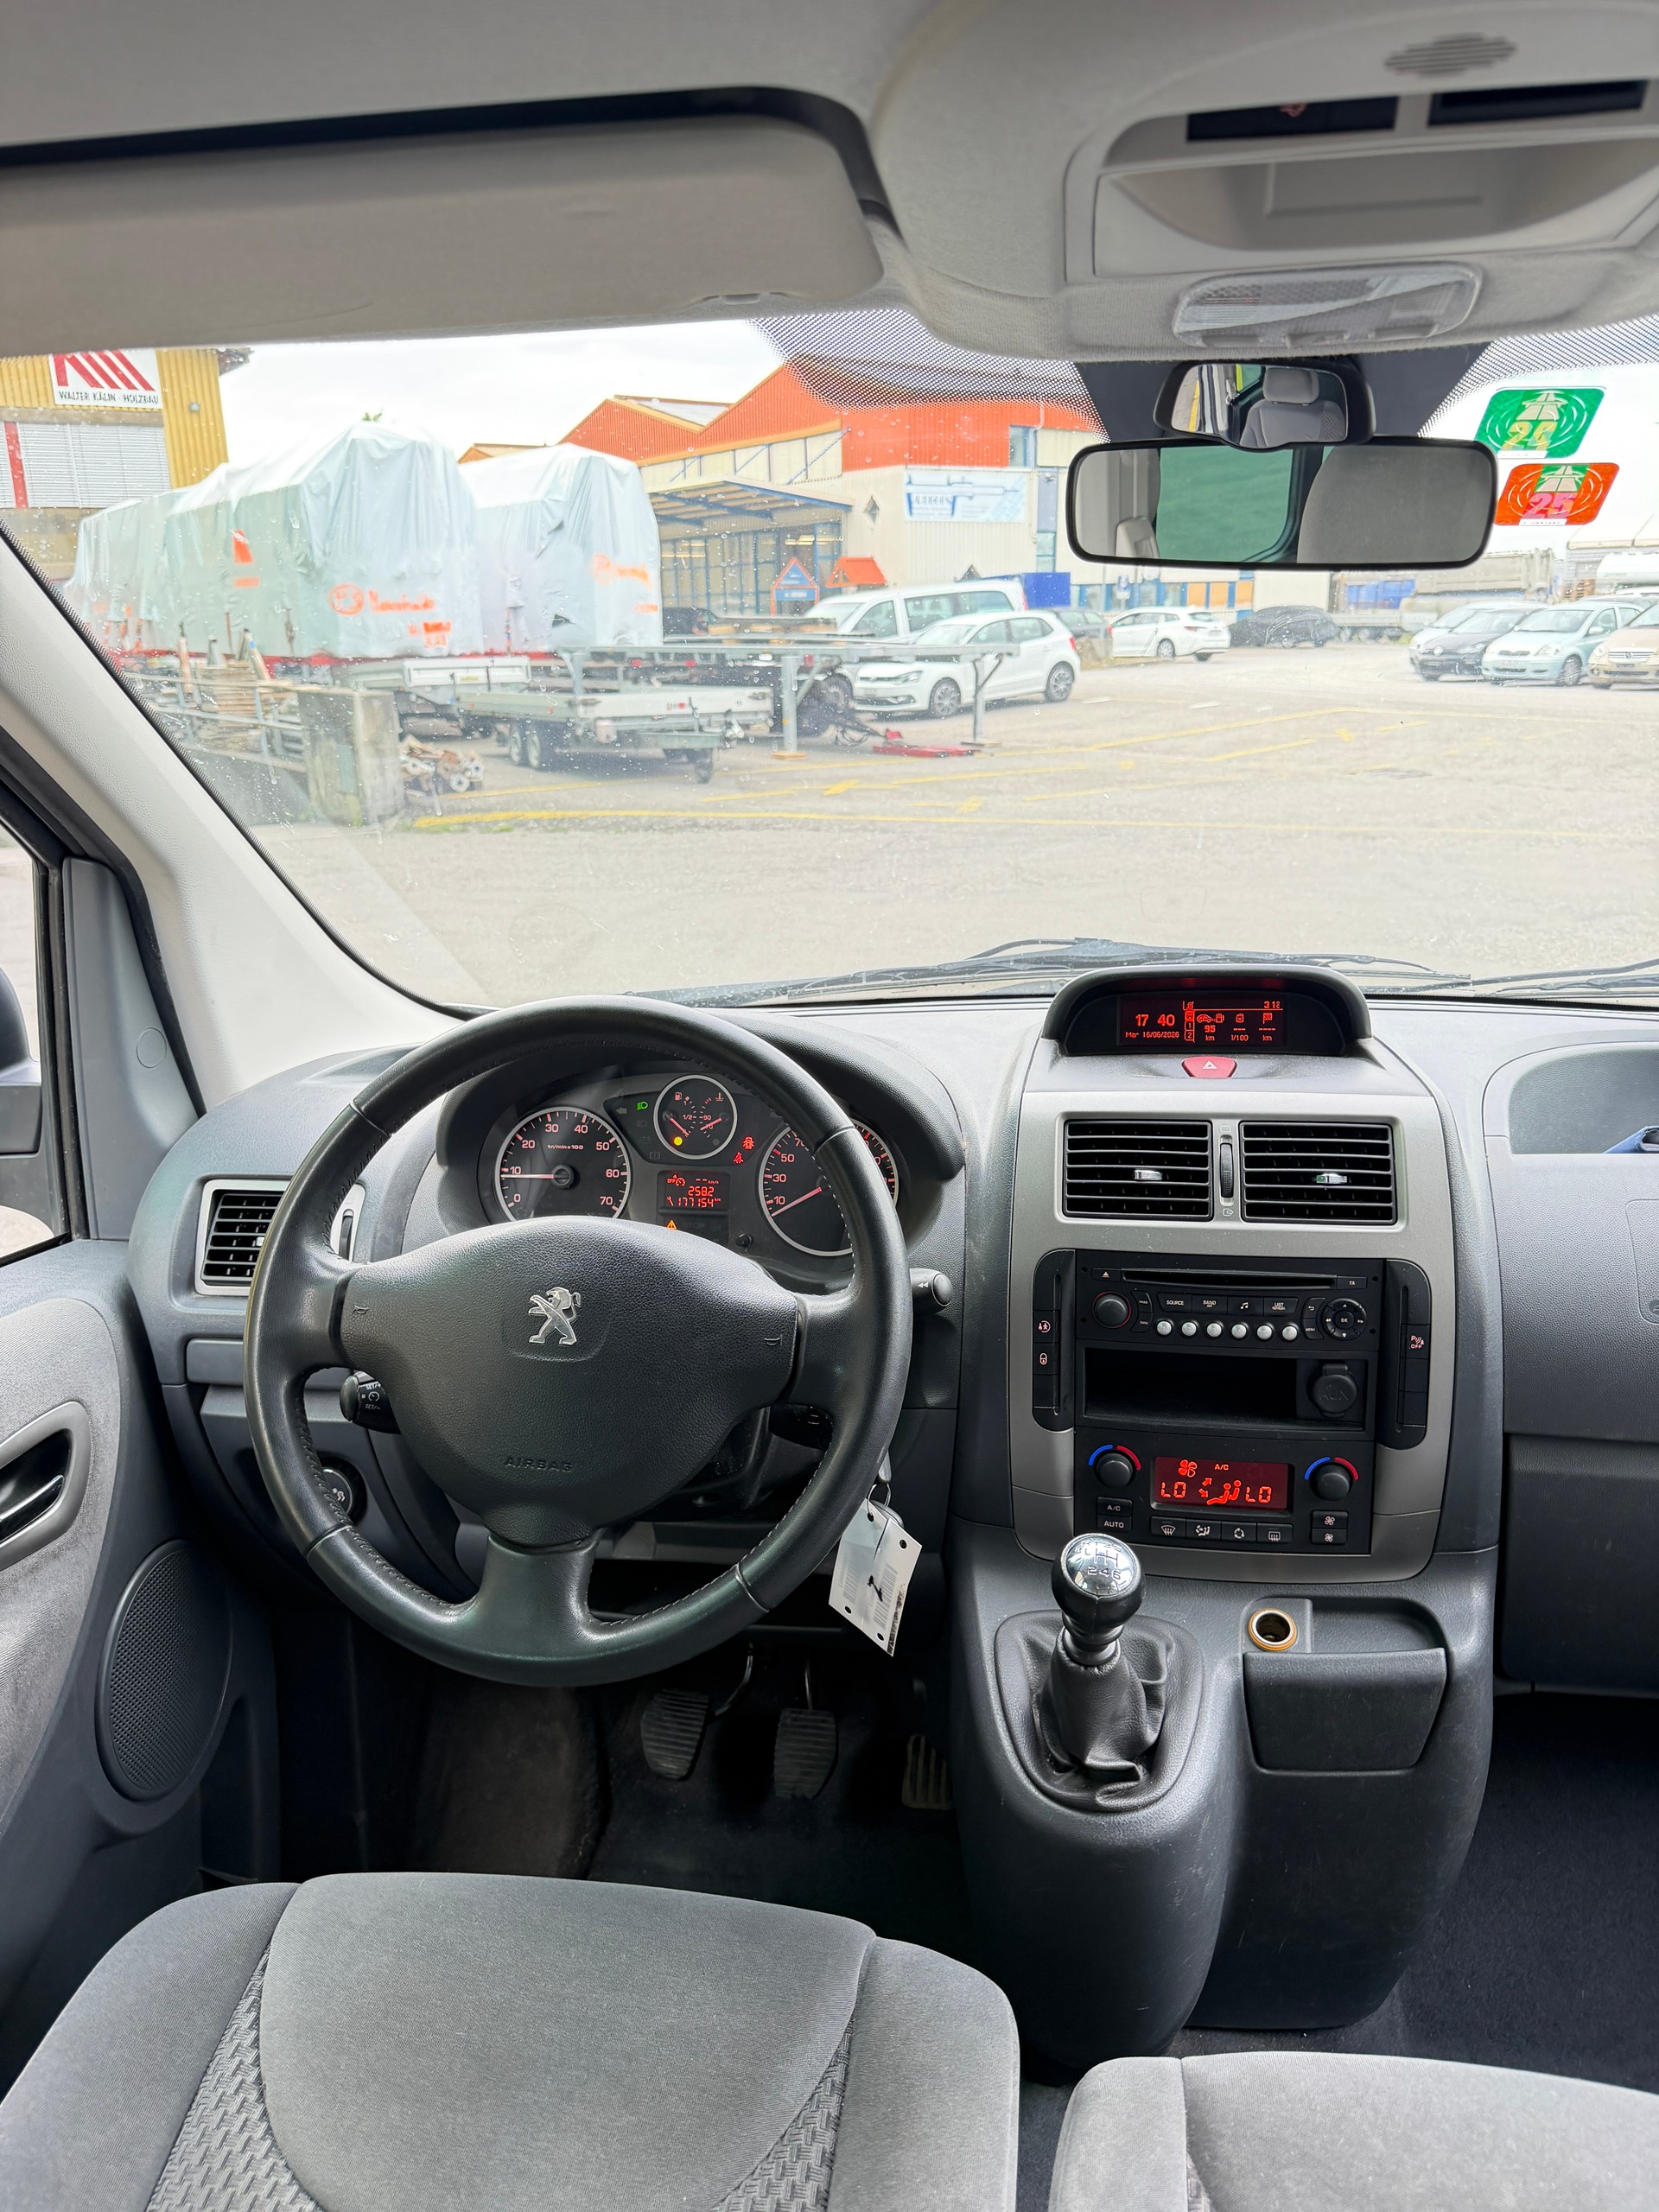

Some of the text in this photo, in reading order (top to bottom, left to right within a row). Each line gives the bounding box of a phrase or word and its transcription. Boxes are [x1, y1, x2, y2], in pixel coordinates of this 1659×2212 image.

[1522, 493, 1578, 518] 25
[1135, 1014, 1175, 1027] 17 40
[1204, 1025, 1216, 1033] 95
[545, 1123, 559, 1133] 30
[574, 1124, 588, 1134] 40
[521, 1140, 536, 1149] 20
[595, 1141, 610, 1151] 50
[780, 1154, 795, 1163] 50
[510, 1166, 522, 1175] 10
[606, 1168, 620, 1178] 60
[772, 1173, 787, 1183] 30
[513, 1193, 521, 1203] 0
[600, 1196, 613, 1205] 70
[773, 1196, 785, 1205] 10
[505, 1457, 573, 1472] AIRBAG
[1103, 1520, 1124, 1529] AUTO
[1088, 1566, 1122, 1580] 2 4 6
